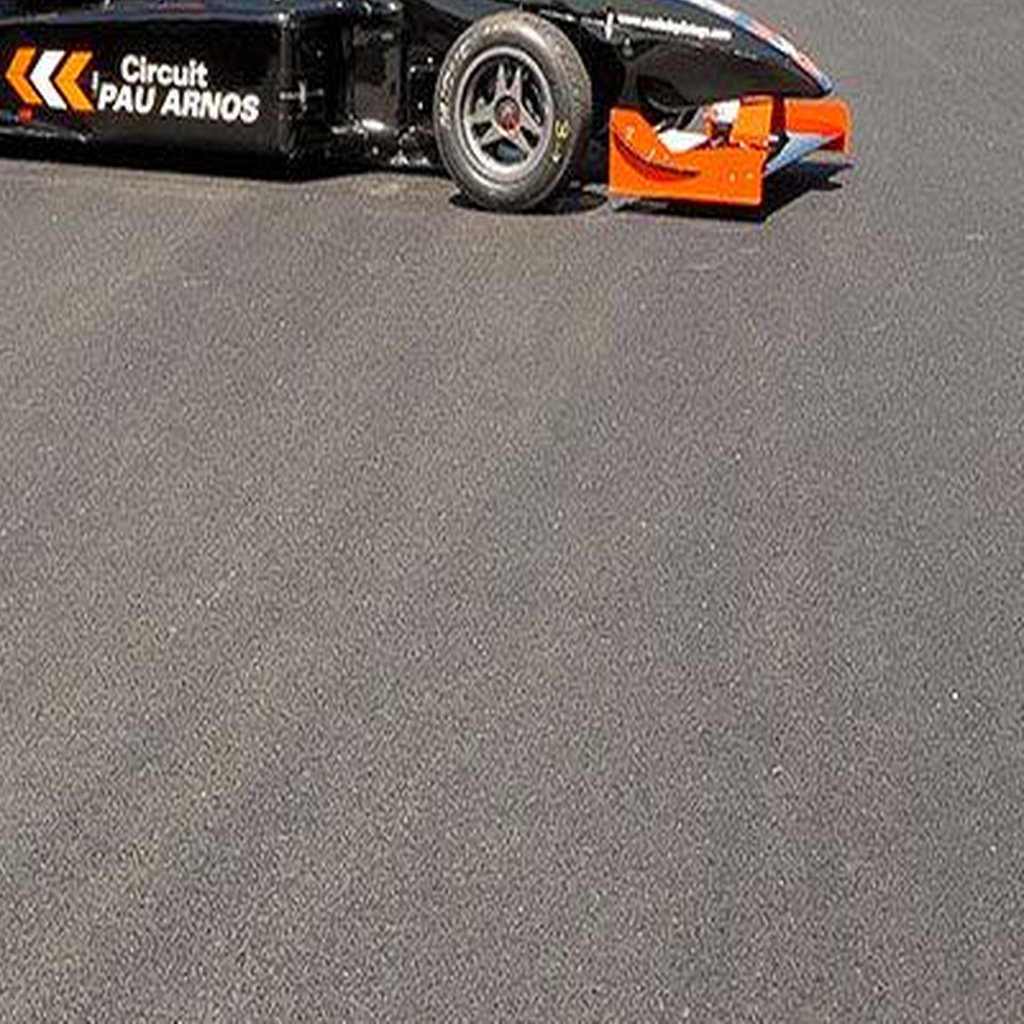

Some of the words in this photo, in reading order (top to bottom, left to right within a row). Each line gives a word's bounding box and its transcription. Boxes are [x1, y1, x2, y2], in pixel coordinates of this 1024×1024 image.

[120, 54, 208, 88] Circuit
[97, 83, 156, 114] PAU
[160, 89, 260, 123] ARNOS
